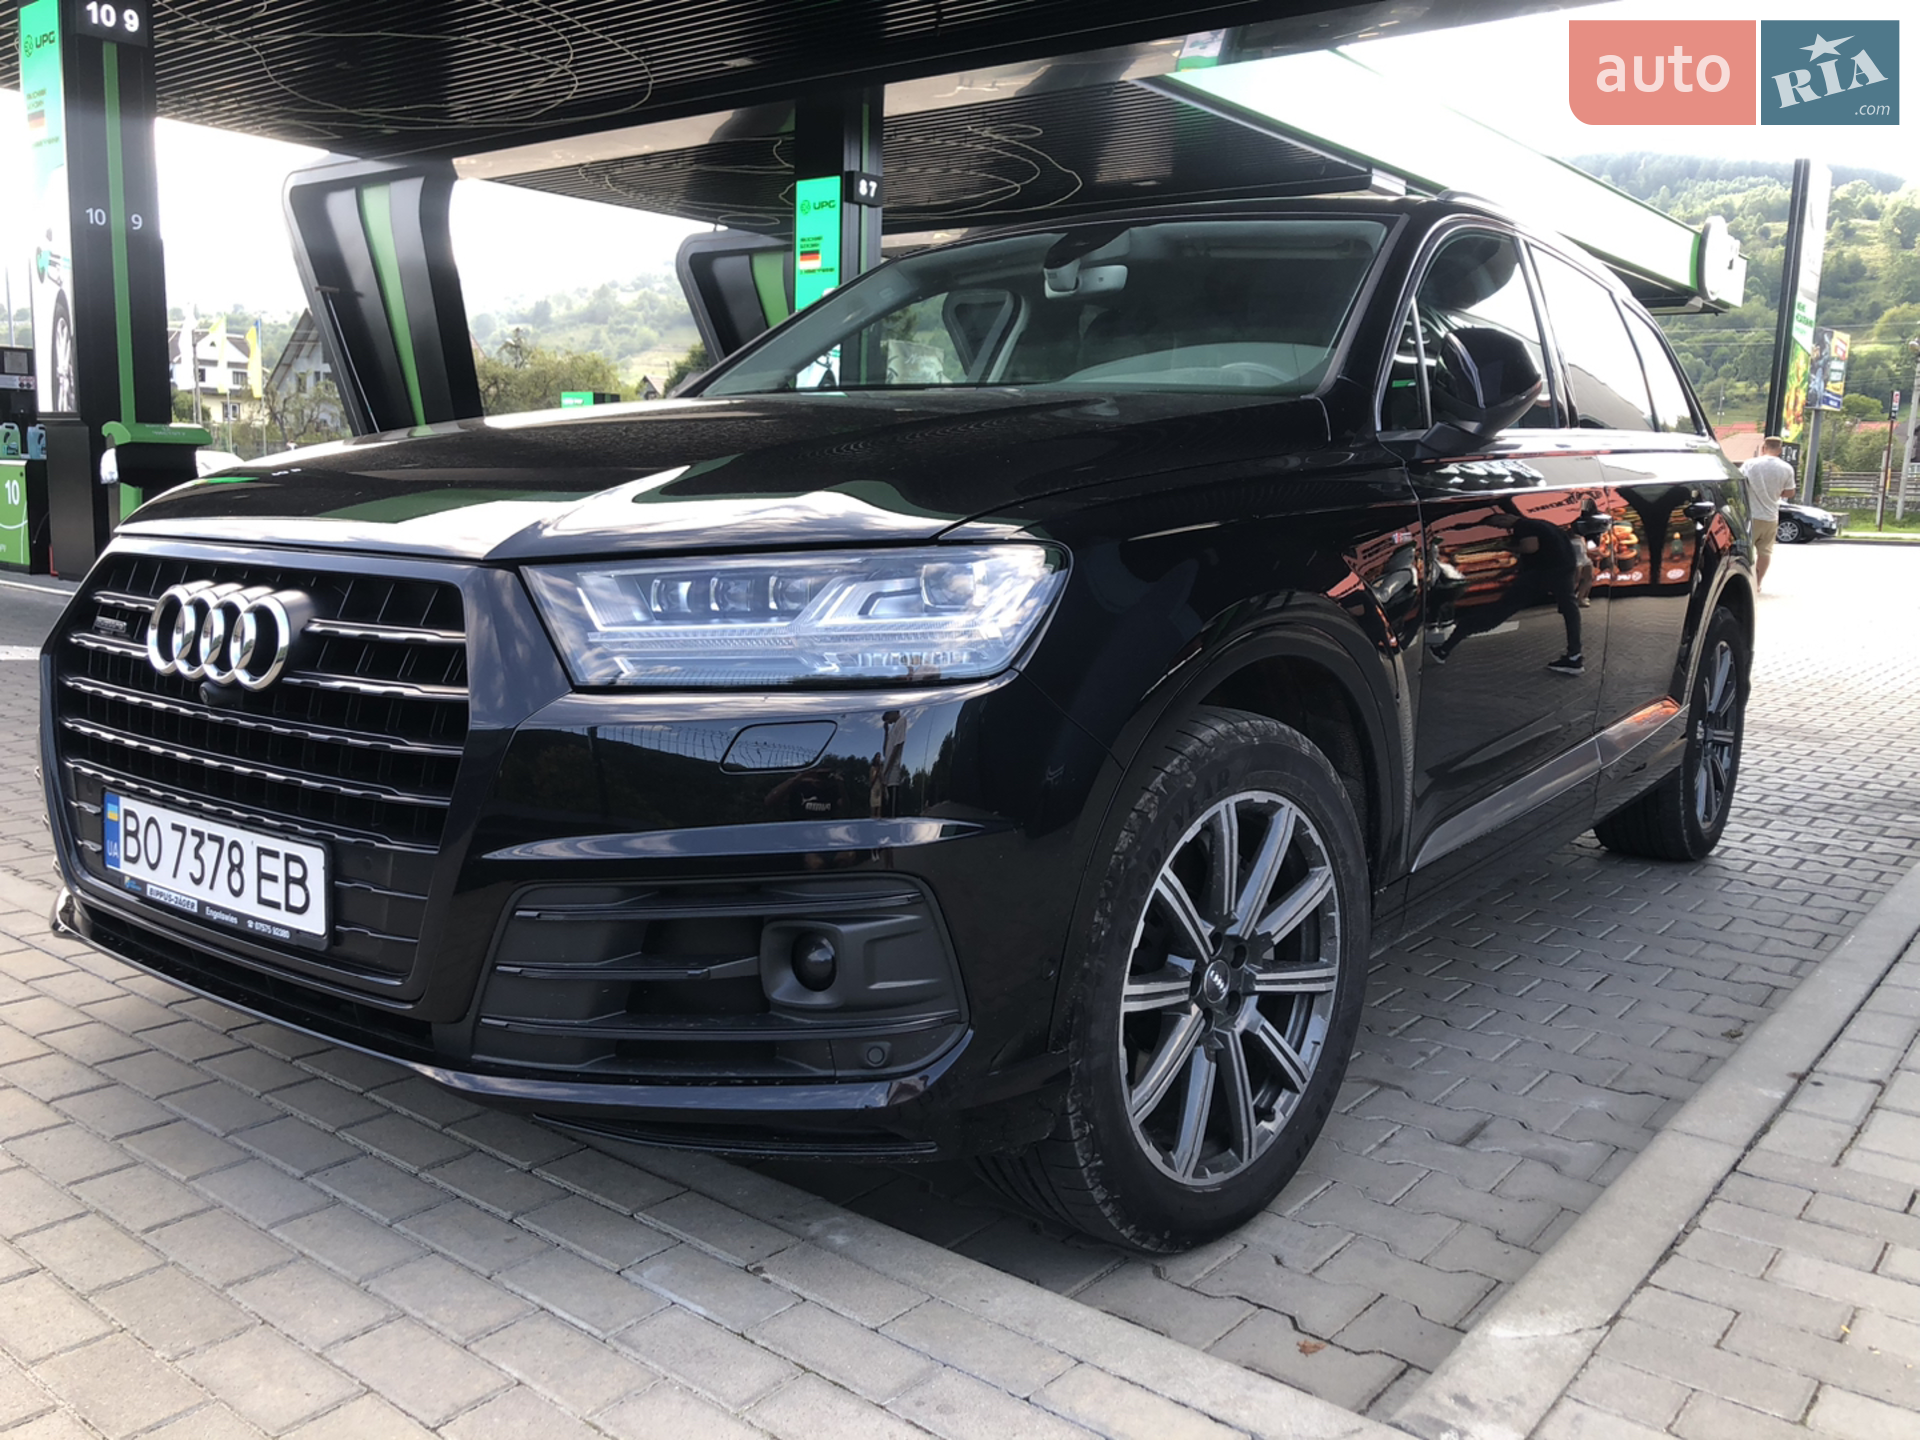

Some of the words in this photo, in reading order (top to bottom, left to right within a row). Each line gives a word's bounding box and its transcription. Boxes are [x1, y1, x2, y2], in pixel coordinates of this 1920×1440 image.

[86, 2, 117, 28] 10
[122, 8, 140, 33] 9
[35, 31, 56, 49] UPG
[813, 199, 836, 211] UPG
[86, 207, 107, 226] 10
[131, 214, 143, 230] 9
[5, 479, 20, 505] 10
[107, 839, 119, 859] UA
[123, 807, 163, 871] BO
[171, 822, 244, 898] 7378
[256, 846, 311, 916] EB
